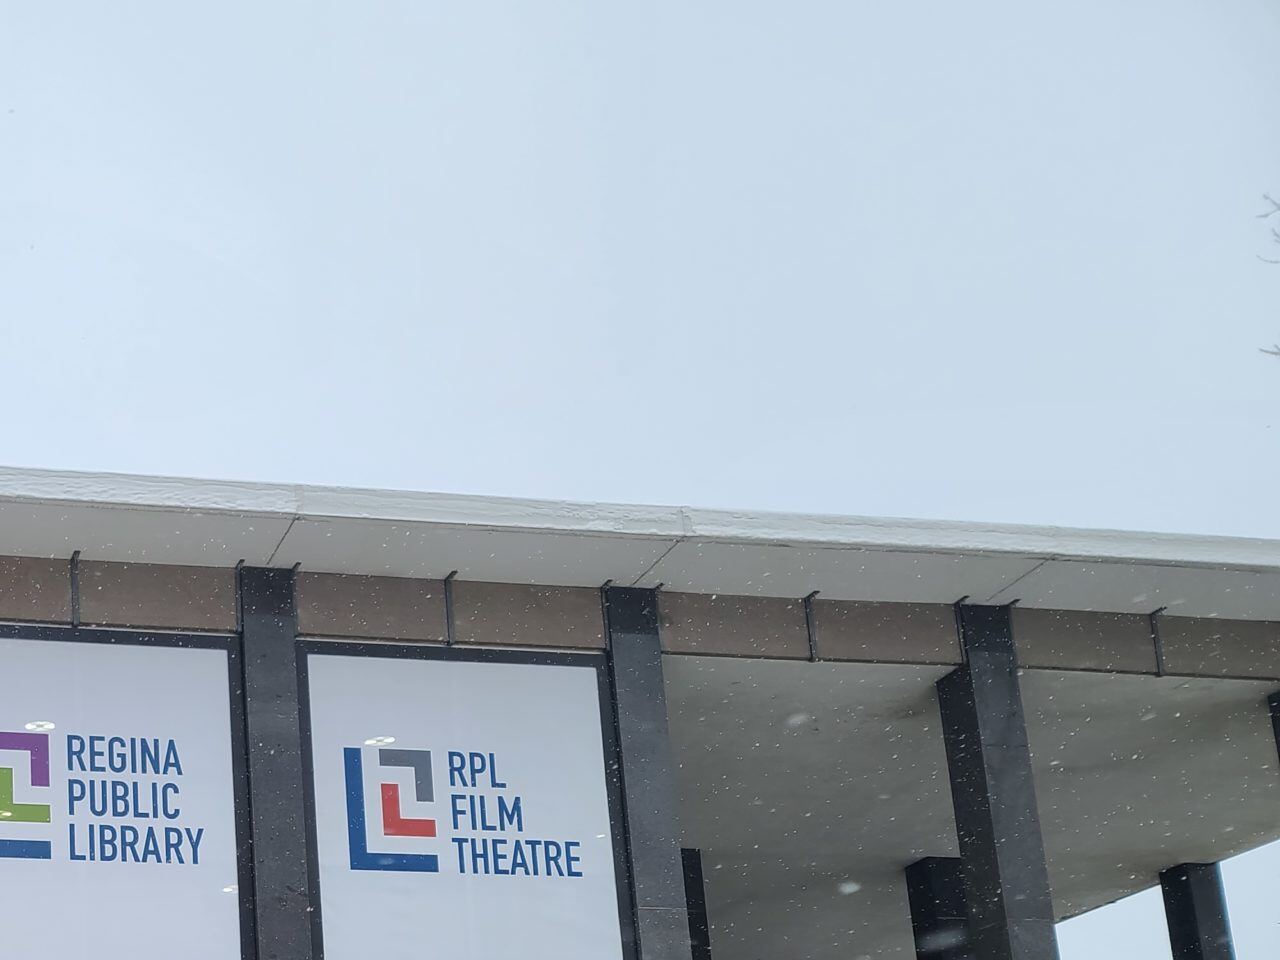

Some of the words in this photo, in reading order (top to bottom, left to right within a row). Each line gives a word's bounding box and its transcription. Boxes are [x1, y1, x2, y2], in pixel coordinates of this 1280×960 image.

[66, 735, 183, 775] REGINA
[447, 751, 508, 788] RPL
[67, 780, 180, 820] PUBLIC
[451, 796, 524, 832] FILM
[69, 824, 204, 865] LIBRARY
[451, 838, 583, 878] THEATRE
